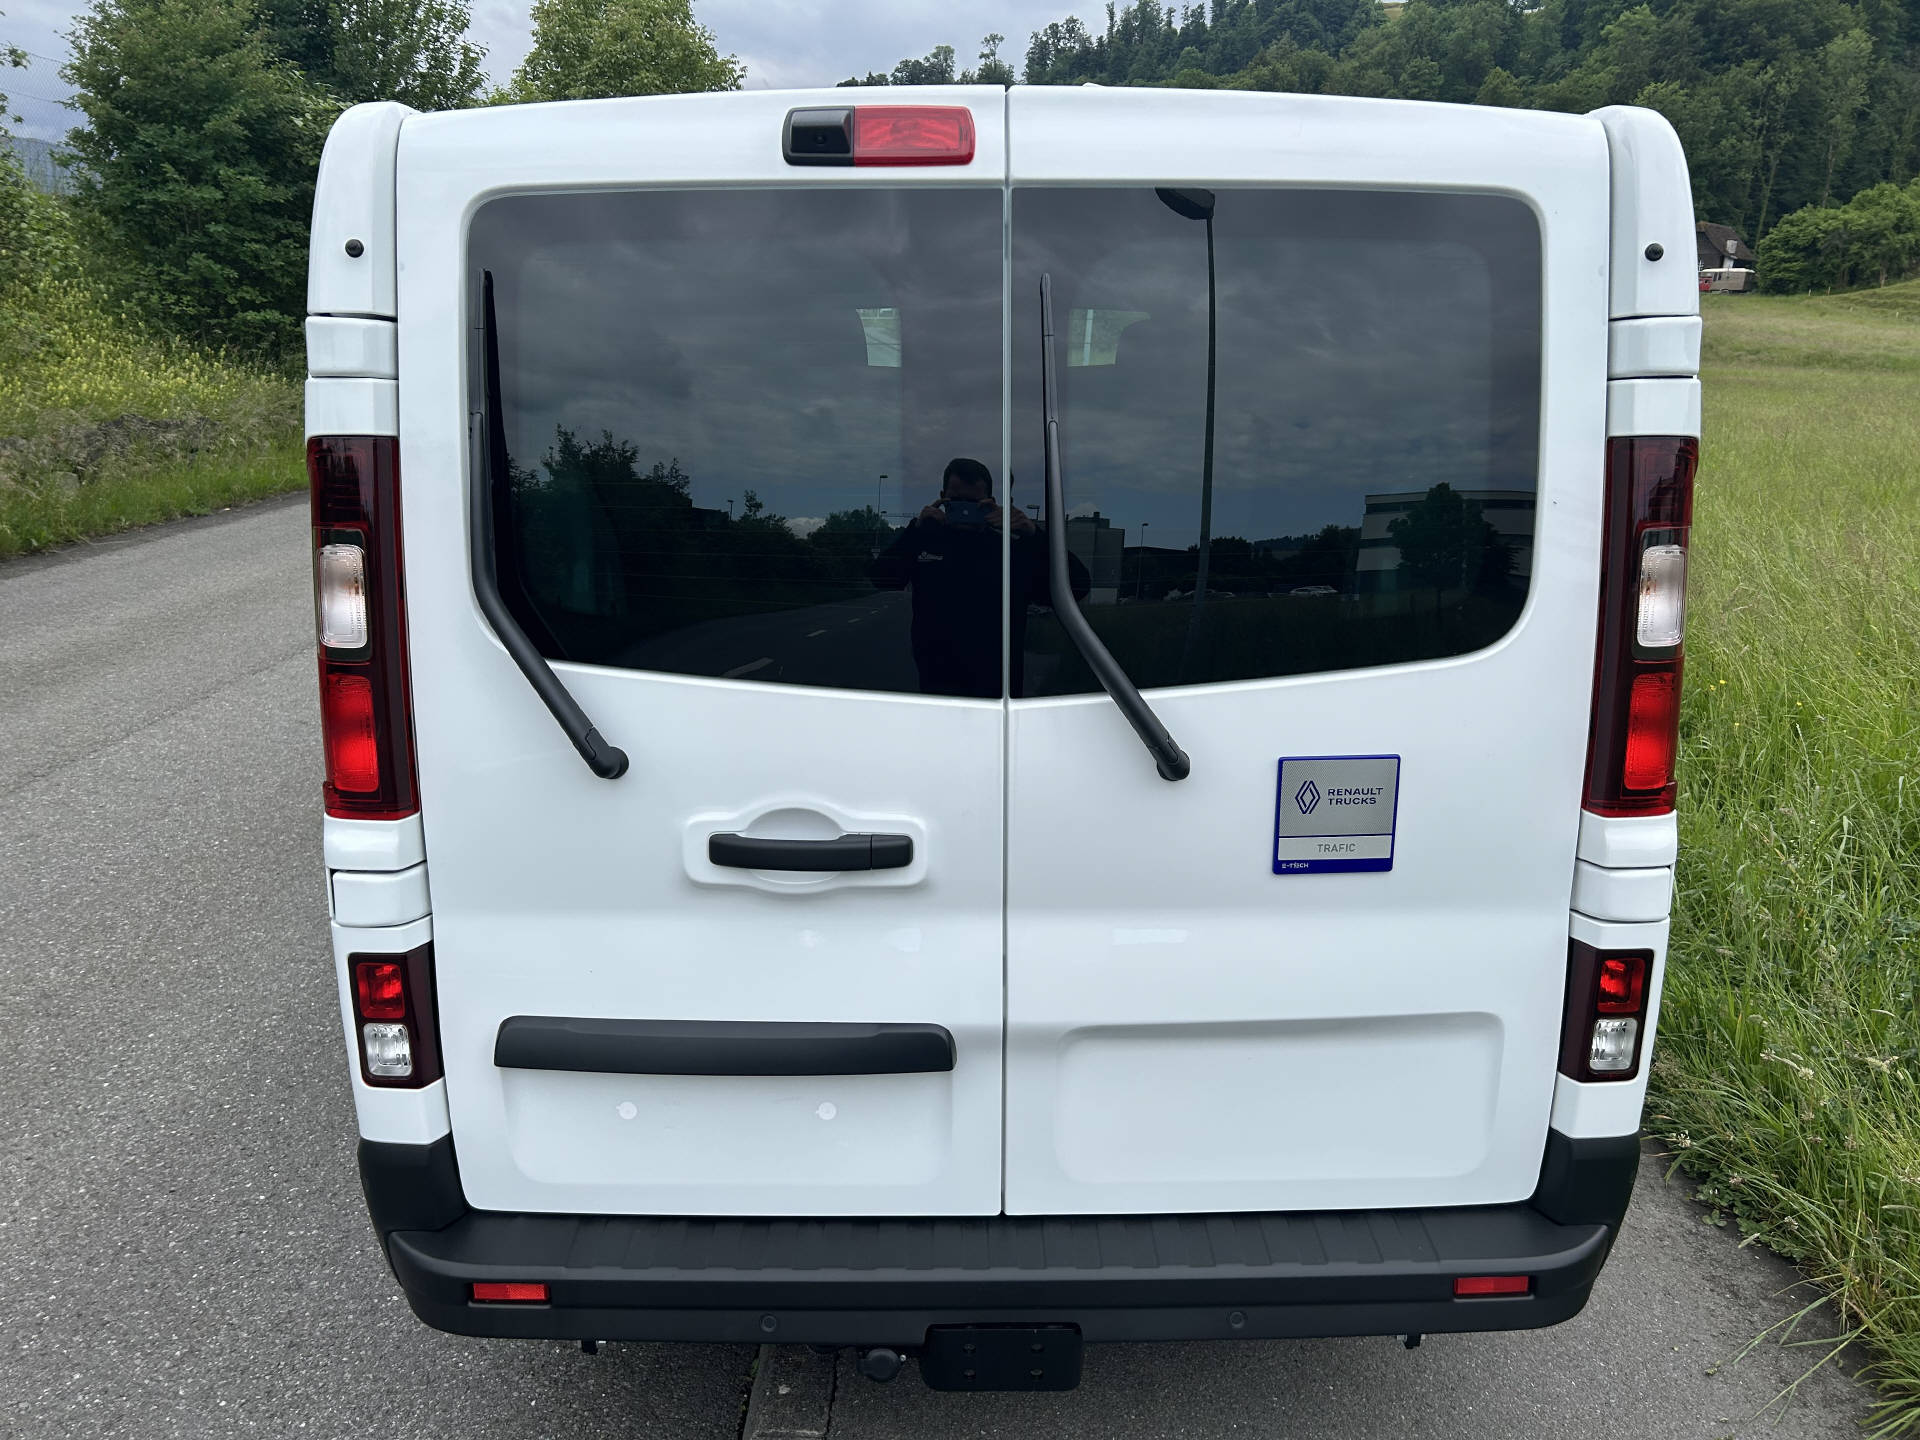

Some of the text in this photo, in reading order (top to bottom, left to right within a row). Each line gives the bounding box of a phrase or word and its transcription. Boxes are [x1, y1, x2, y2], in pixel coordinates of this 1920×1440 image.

[1328, 788, 1383, 796] RENAULT
[1328, 797, 1377, 805] TRUCKS
[1317, 843, 1356, 853] TRAFIC
